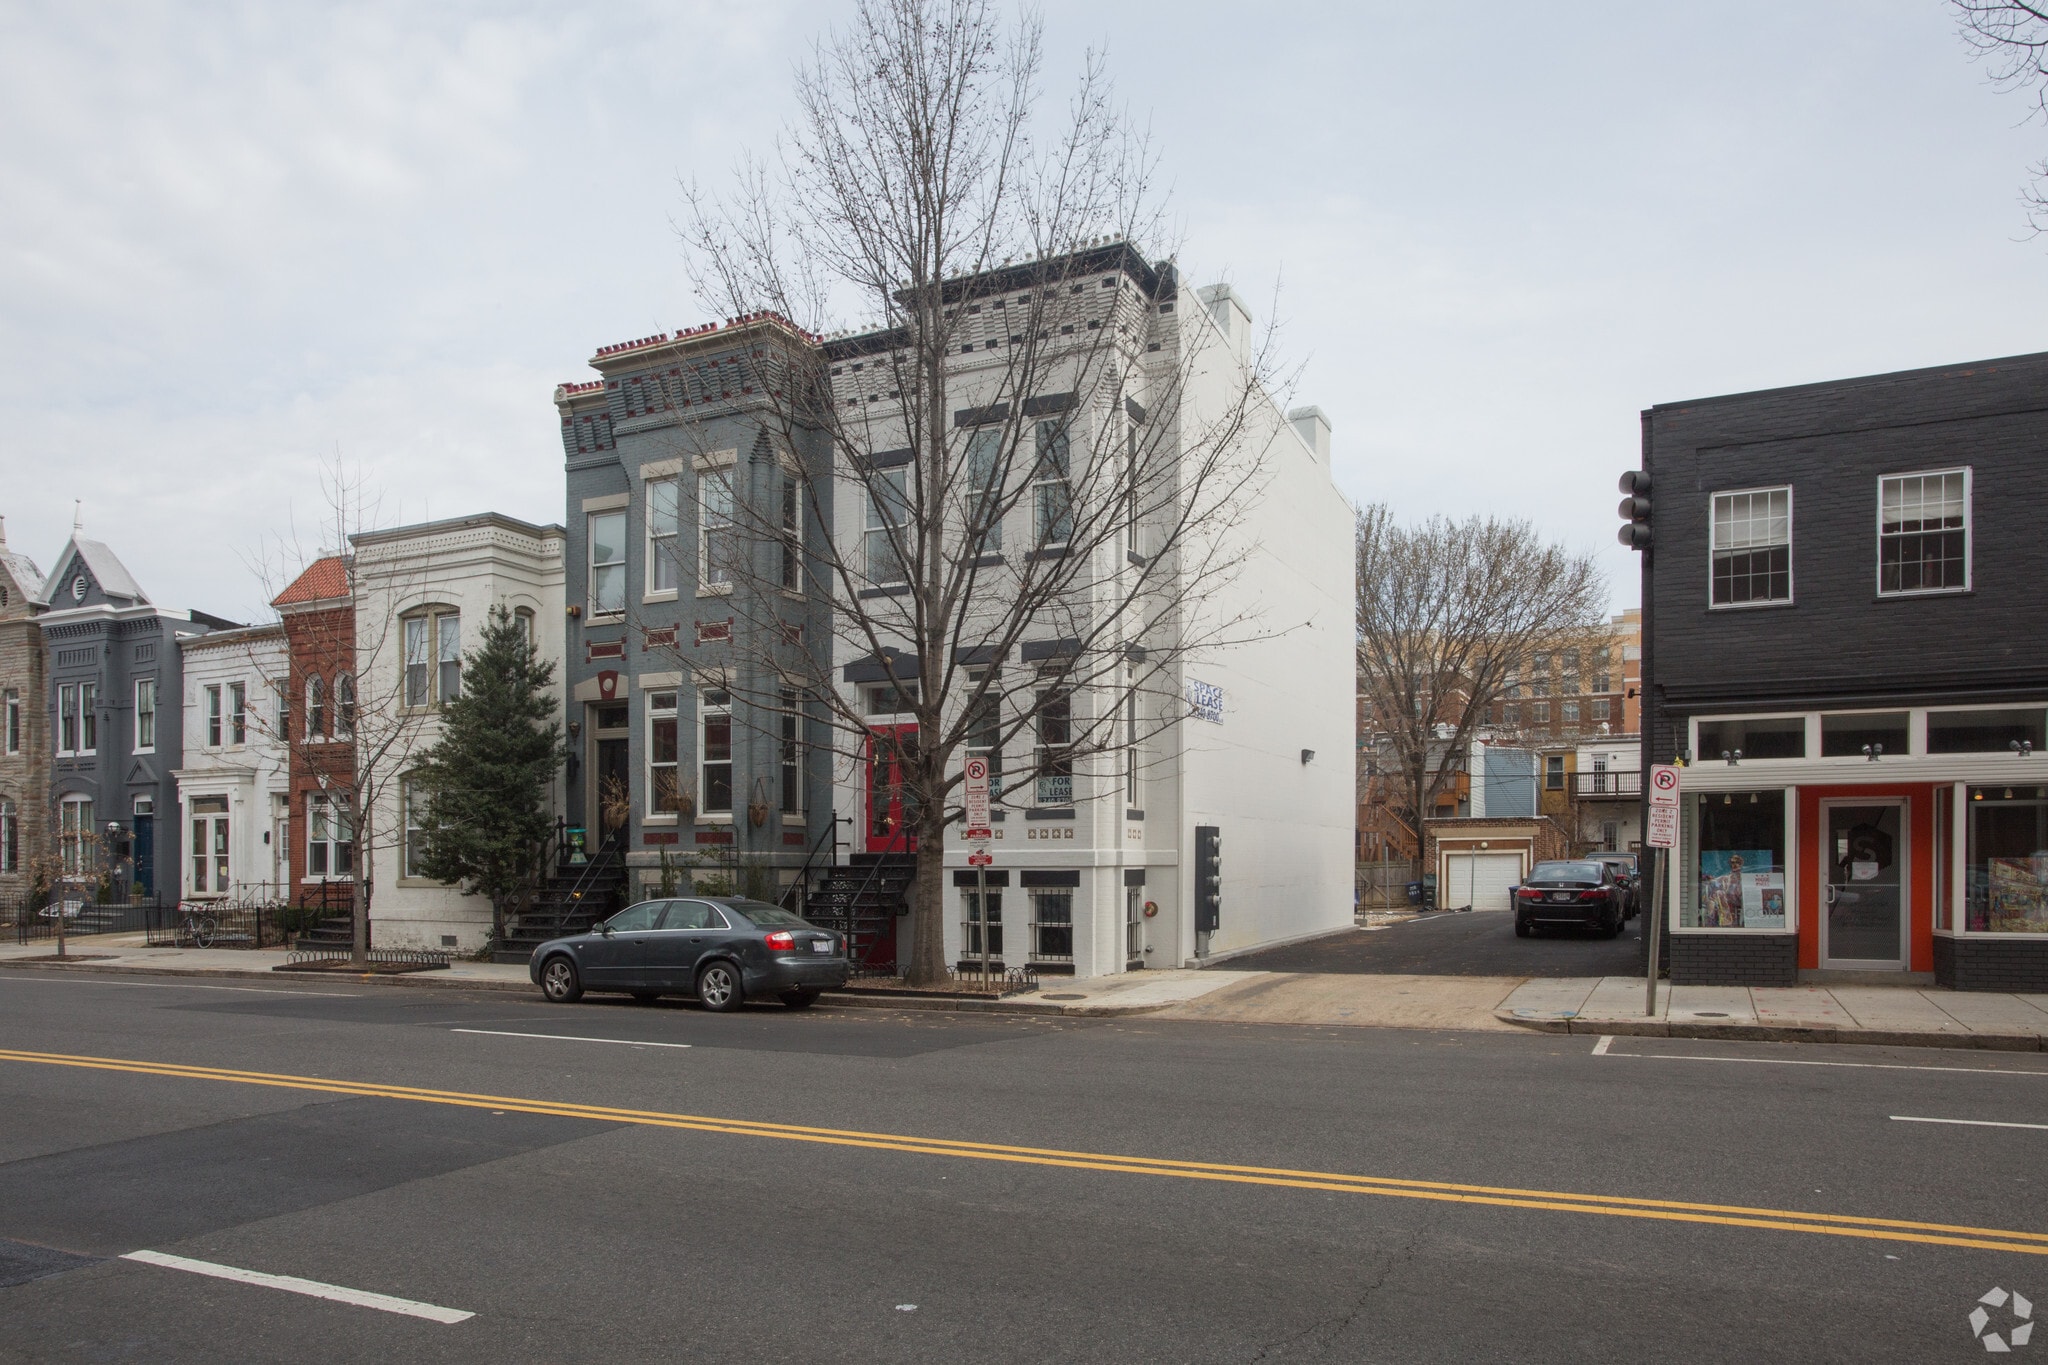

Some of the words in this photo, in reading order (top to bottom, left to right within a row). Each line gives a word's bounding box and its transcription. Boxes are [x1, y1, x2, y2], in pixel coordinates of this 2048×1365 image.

[1194, 681, 1223, 699] SPACE
[1196, 692, 1223, 711] LEASE
[1052, 777, 1070, 785] FOR
[1049, 787, 1072, 796] LEASE
